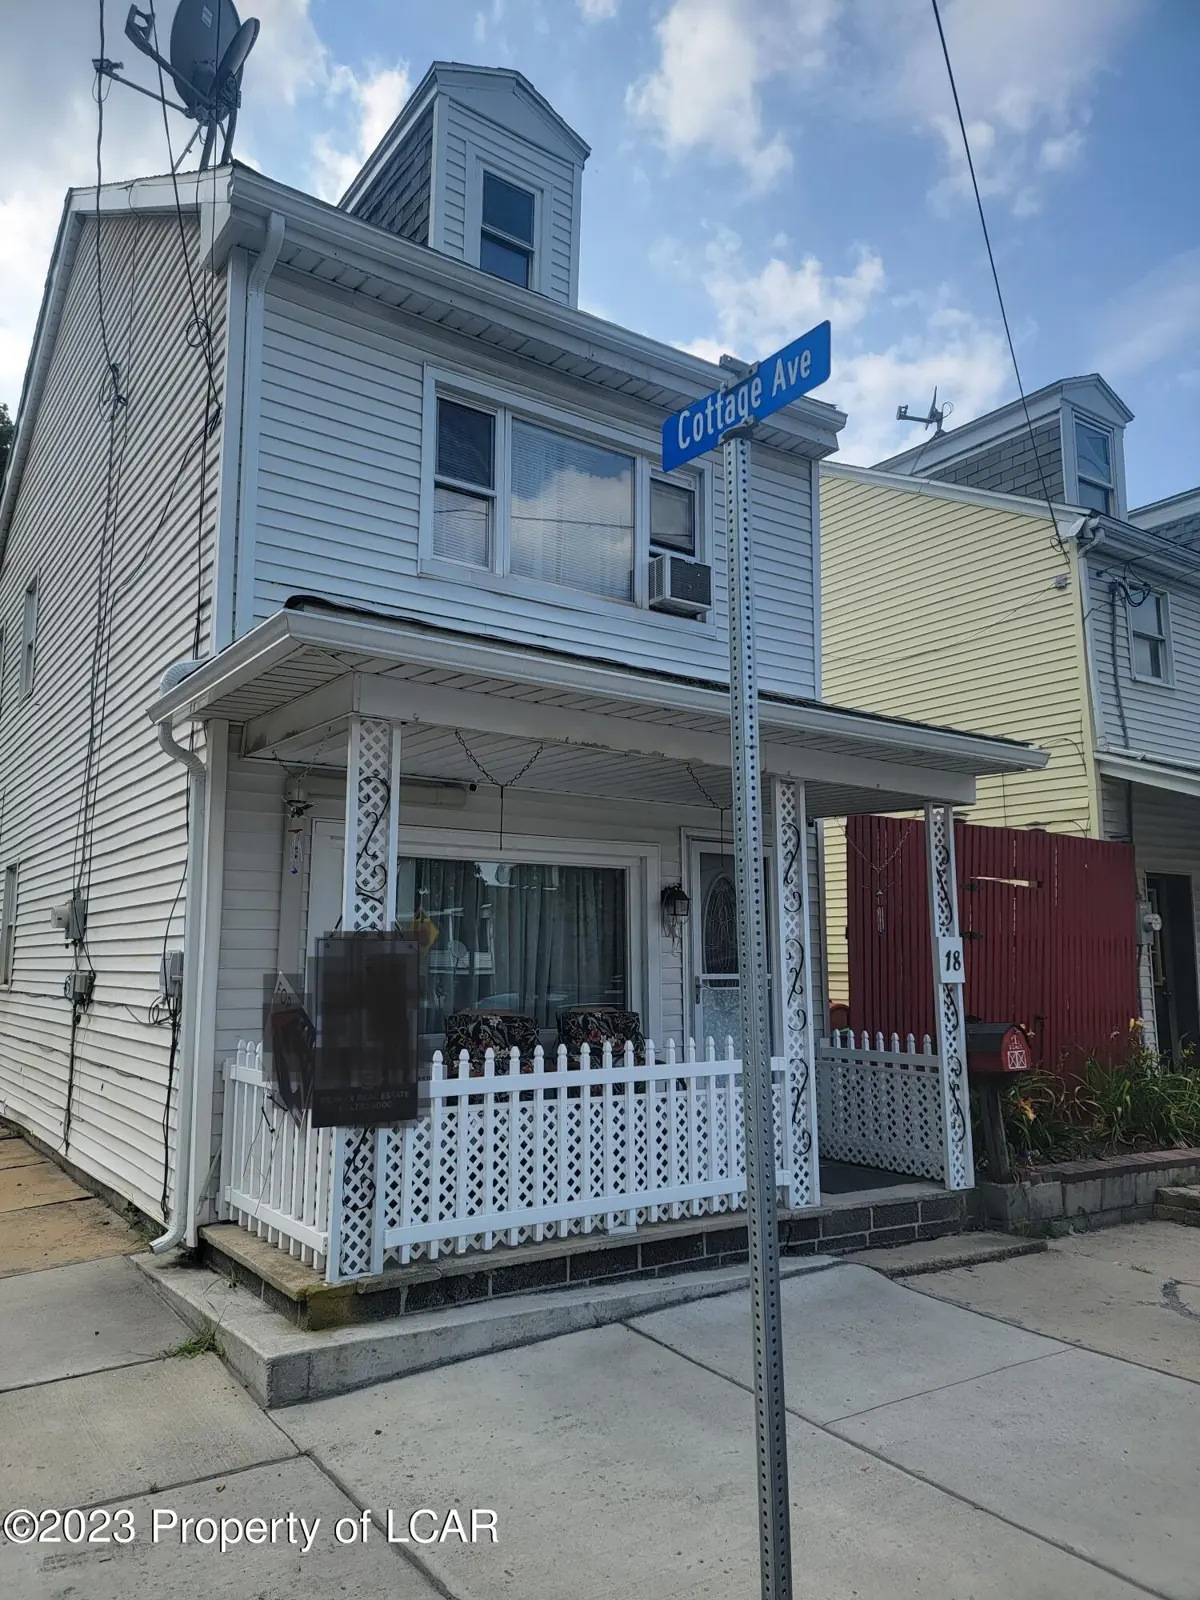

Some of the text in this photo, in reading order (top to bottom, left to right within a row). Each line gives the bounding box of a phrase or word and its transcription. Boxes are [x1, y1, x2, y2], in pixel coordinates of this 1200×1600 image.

[677, 349, 811, 449] Cottage Ave
[945, 949, 962, 972] 18
